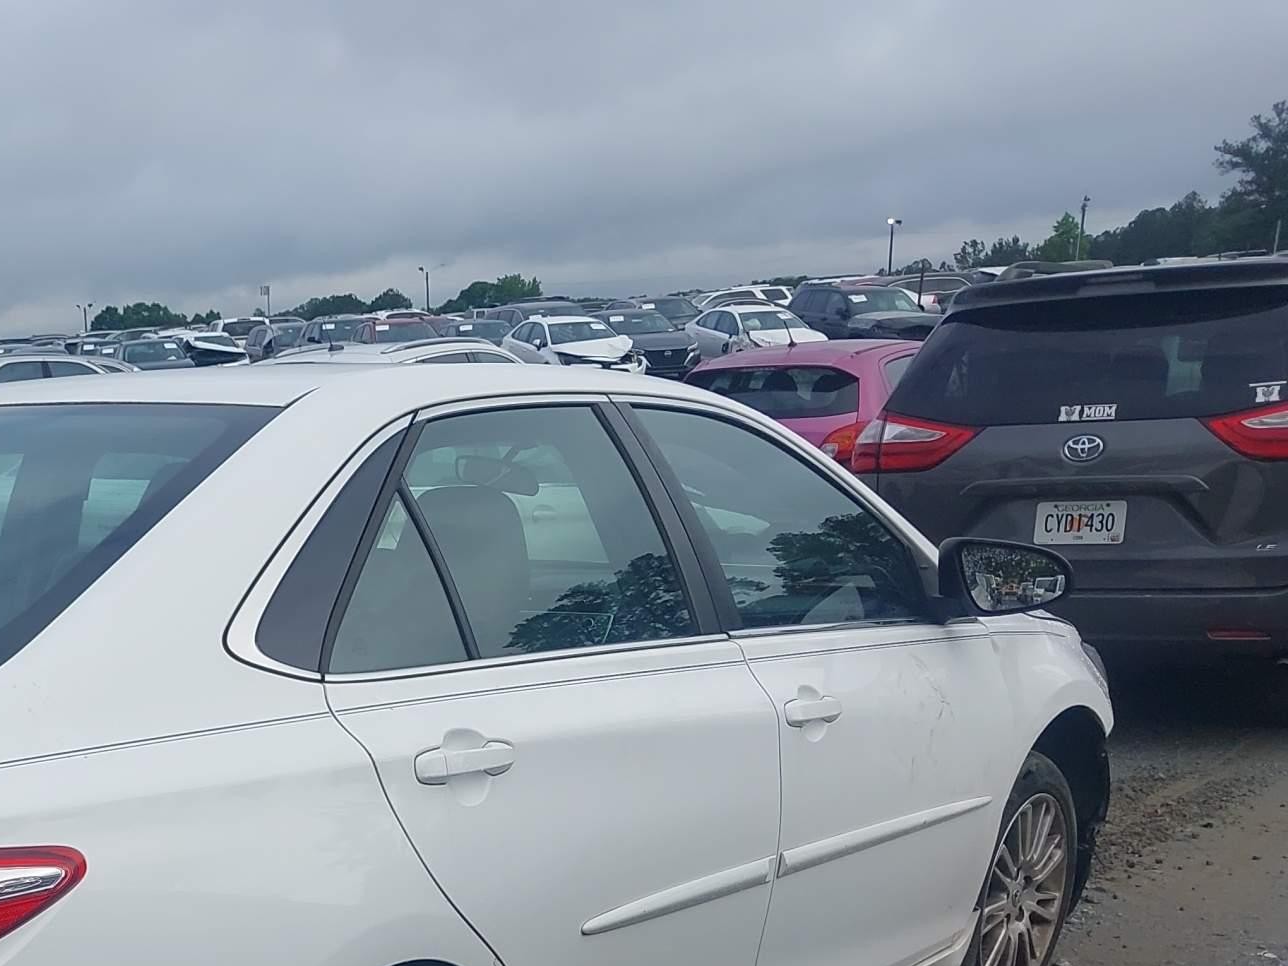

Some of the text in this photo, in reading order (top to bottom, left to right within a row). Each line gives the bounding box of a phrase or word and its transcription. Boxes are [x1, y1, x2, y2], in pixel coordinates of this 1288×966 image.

[1083, 406, 1116, 417] MOM
[1056, 504, 1105, 512] GEORGIA
[1044, 512, 1115, 533] CYD1430
